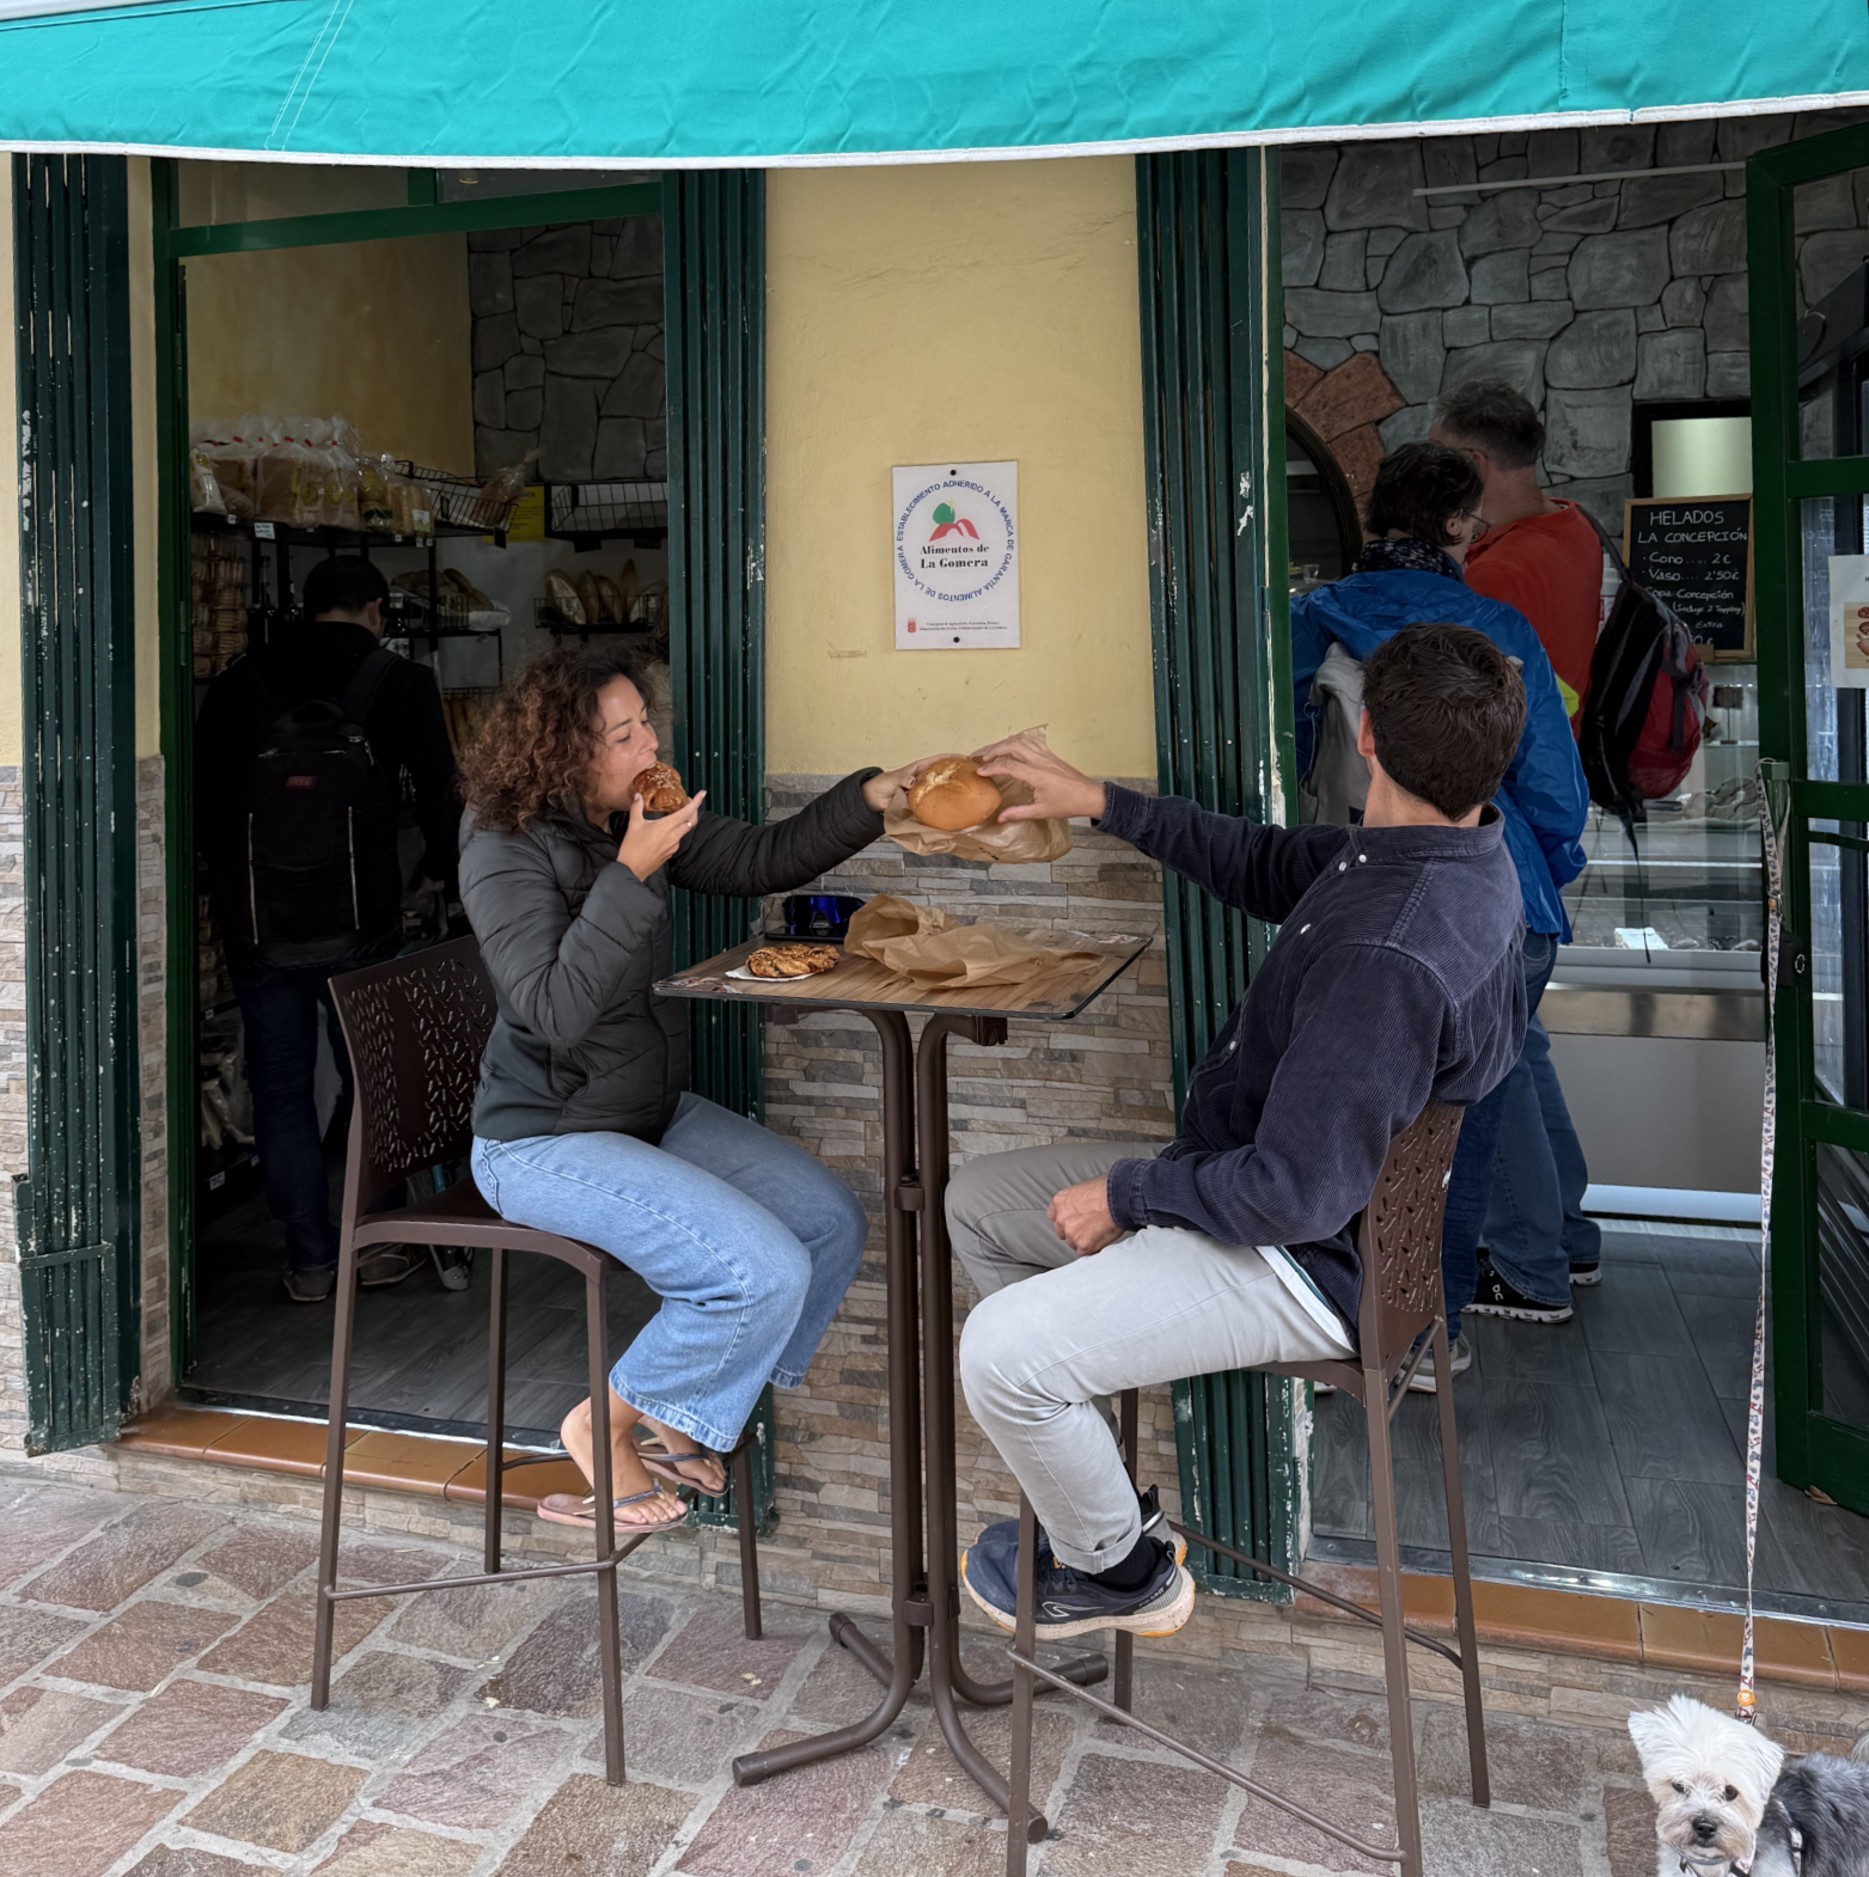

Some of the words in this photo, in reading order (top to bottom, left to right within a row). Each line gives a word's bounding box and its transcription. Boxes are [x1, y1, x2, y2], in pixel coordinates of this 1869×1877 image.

[943, 480, 984, 493] ADHERIDO
[984, 490, 991, 498] A
[990, 495, 1001, 507] LA
[896, 484, 940, 541] ESTABLECIMIENTO
[1650, 510, 1724, 526] HELADOS
[1000, 507, 1014, 537] MARCA
[1637, 531, 1658, 544] LA
[1664, 527, 1747, 543] CONCEPCIÓN
[920, 545, 974, 554] Alimentos
[976, 544, 990, 553] de
[1007, 539, 1014, 551] DE
[897, 545, 915, 580] GOMERA
[920, 559, 936, 569] La
[939, 558, 989, 568] Gomera
[1648, 552, 1684, 565] Cono
[1648, 568, 1681, 581] Vaso
[914, 579, 925, 590] LA
[924, 587, 936, 597] DE
[937, 588, 982, 601] ALIMENTOS
[1676, 588, 1734, 602] Concepción
